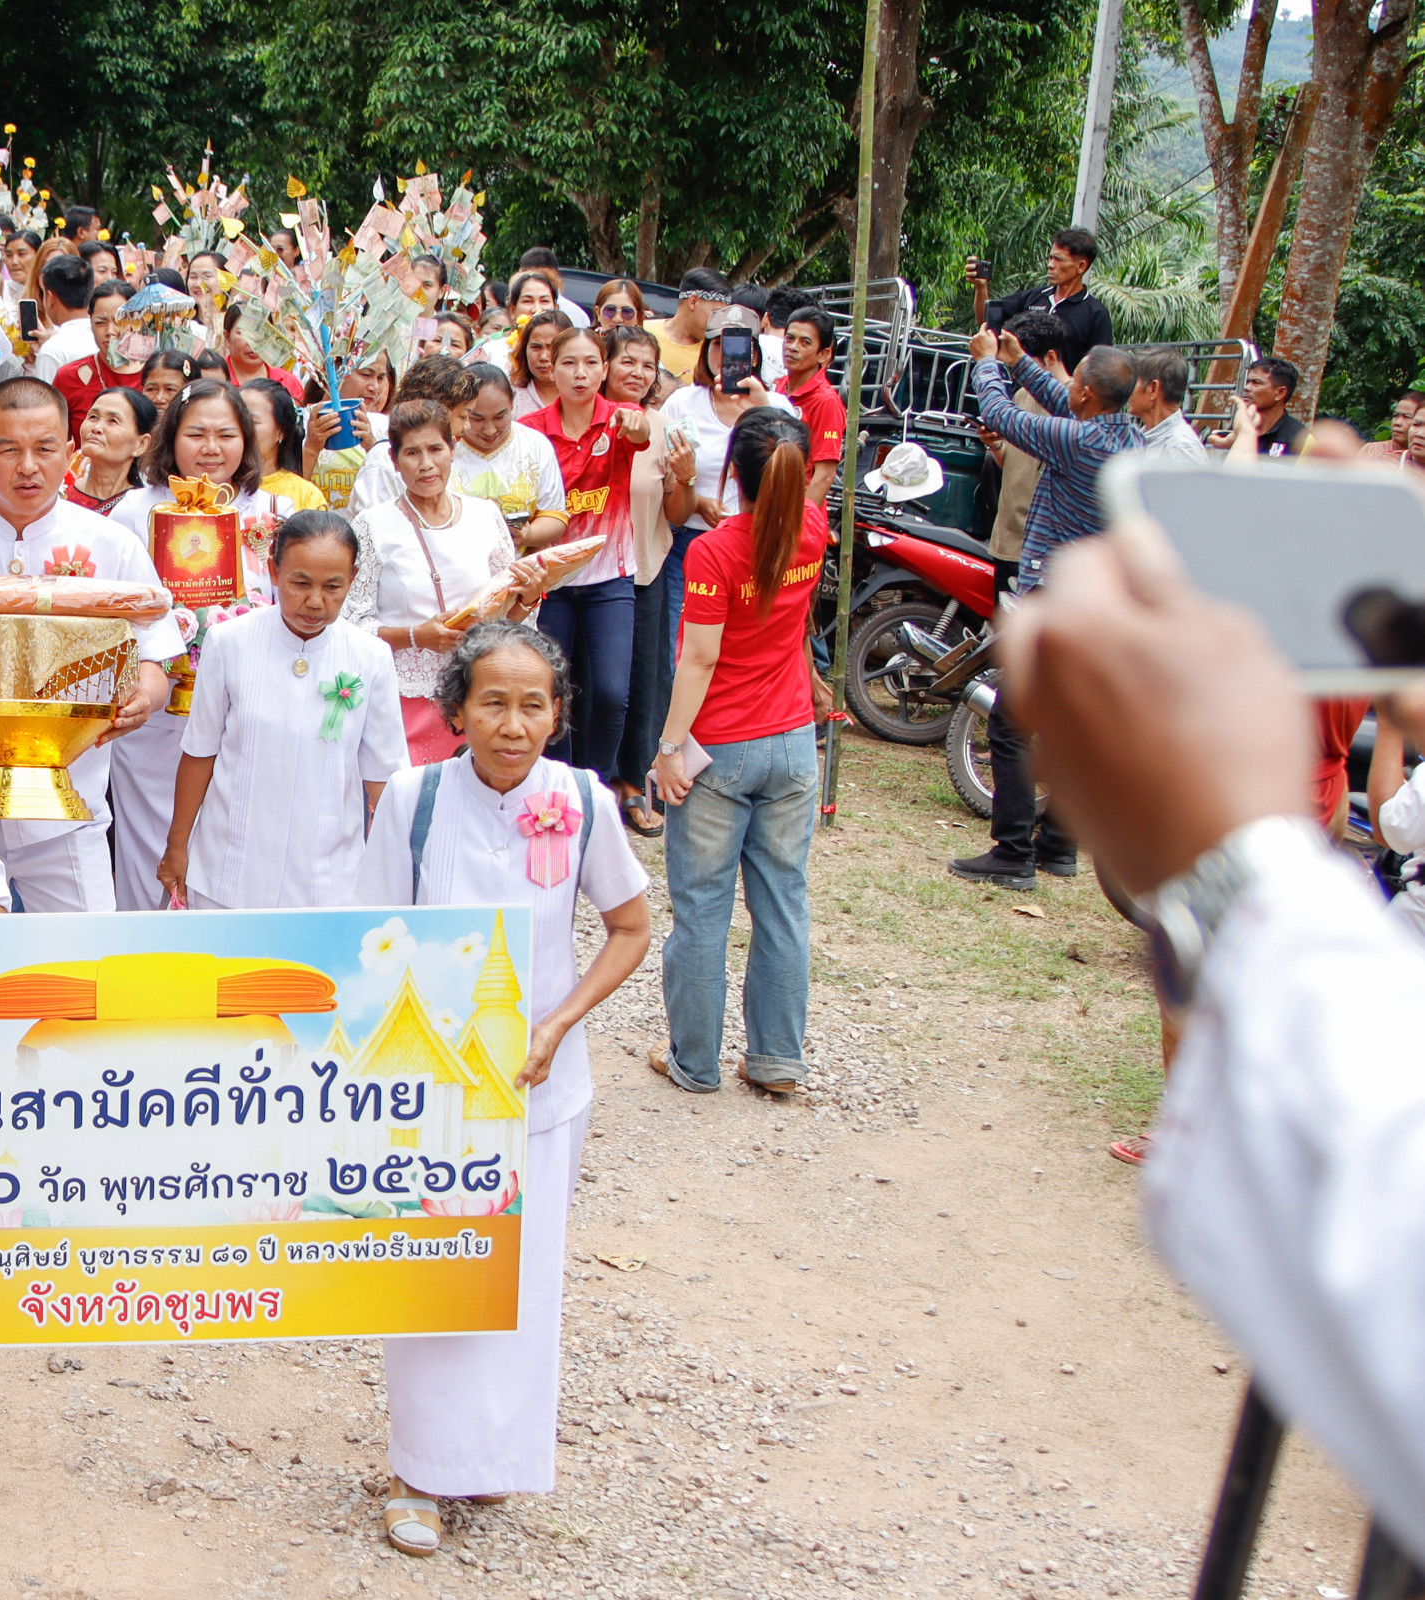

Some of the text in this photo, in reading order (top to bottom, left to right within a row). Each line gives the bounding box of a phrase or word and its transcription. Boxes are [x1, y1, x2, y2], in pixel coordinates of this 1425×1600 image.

[823, 430, 839, 440] M&
[687, 581, 717, 597] M&J
[38, 1165, 86, 1203] วัด
[100, 1162, 308, 1216] พุทธศักราช
[327, 1153, 501, 1196] ๒๕๖๘
[79, 1246, 201, 1274] บูชาธรรม
[212, 1246, 248, 1264] ๘๑
[259, 1237, 277, 1261] ปี
[286, 1232, 490, 1261] หลวงพ่อธัมมชโย
[21, 1281, 281, 1333] จังหวัดชุมพร
